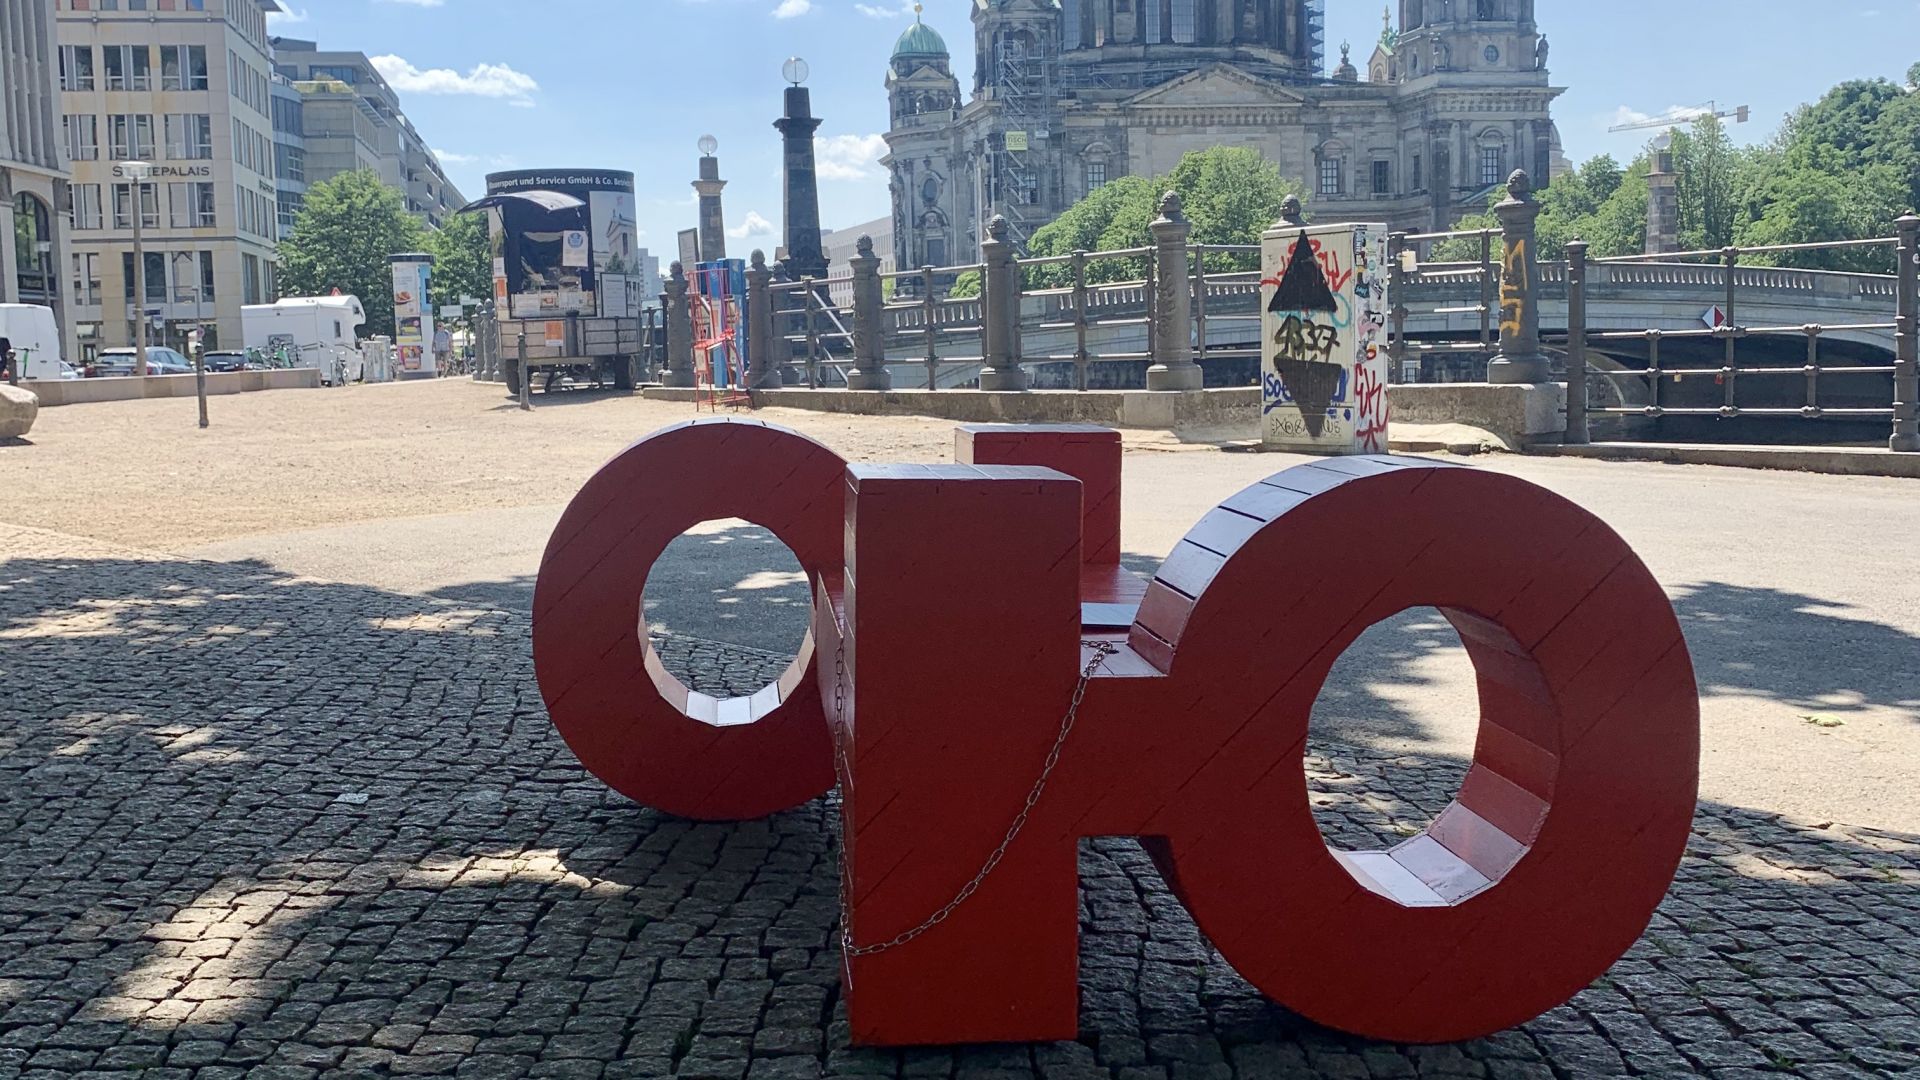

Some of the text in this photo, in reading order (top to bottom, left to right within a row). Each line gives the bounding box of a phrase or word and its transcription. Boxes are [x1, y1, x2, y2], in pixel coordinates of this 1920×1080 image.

[112, 166, 210, 177] SEPALAIS
[520, 176, 534, 185] und
[536, 176, 566, 185] Service
[567, 176, 593, 184] GmbH
[594, 176, 601, 184] &
[602, 177, 613, 185] Co.
